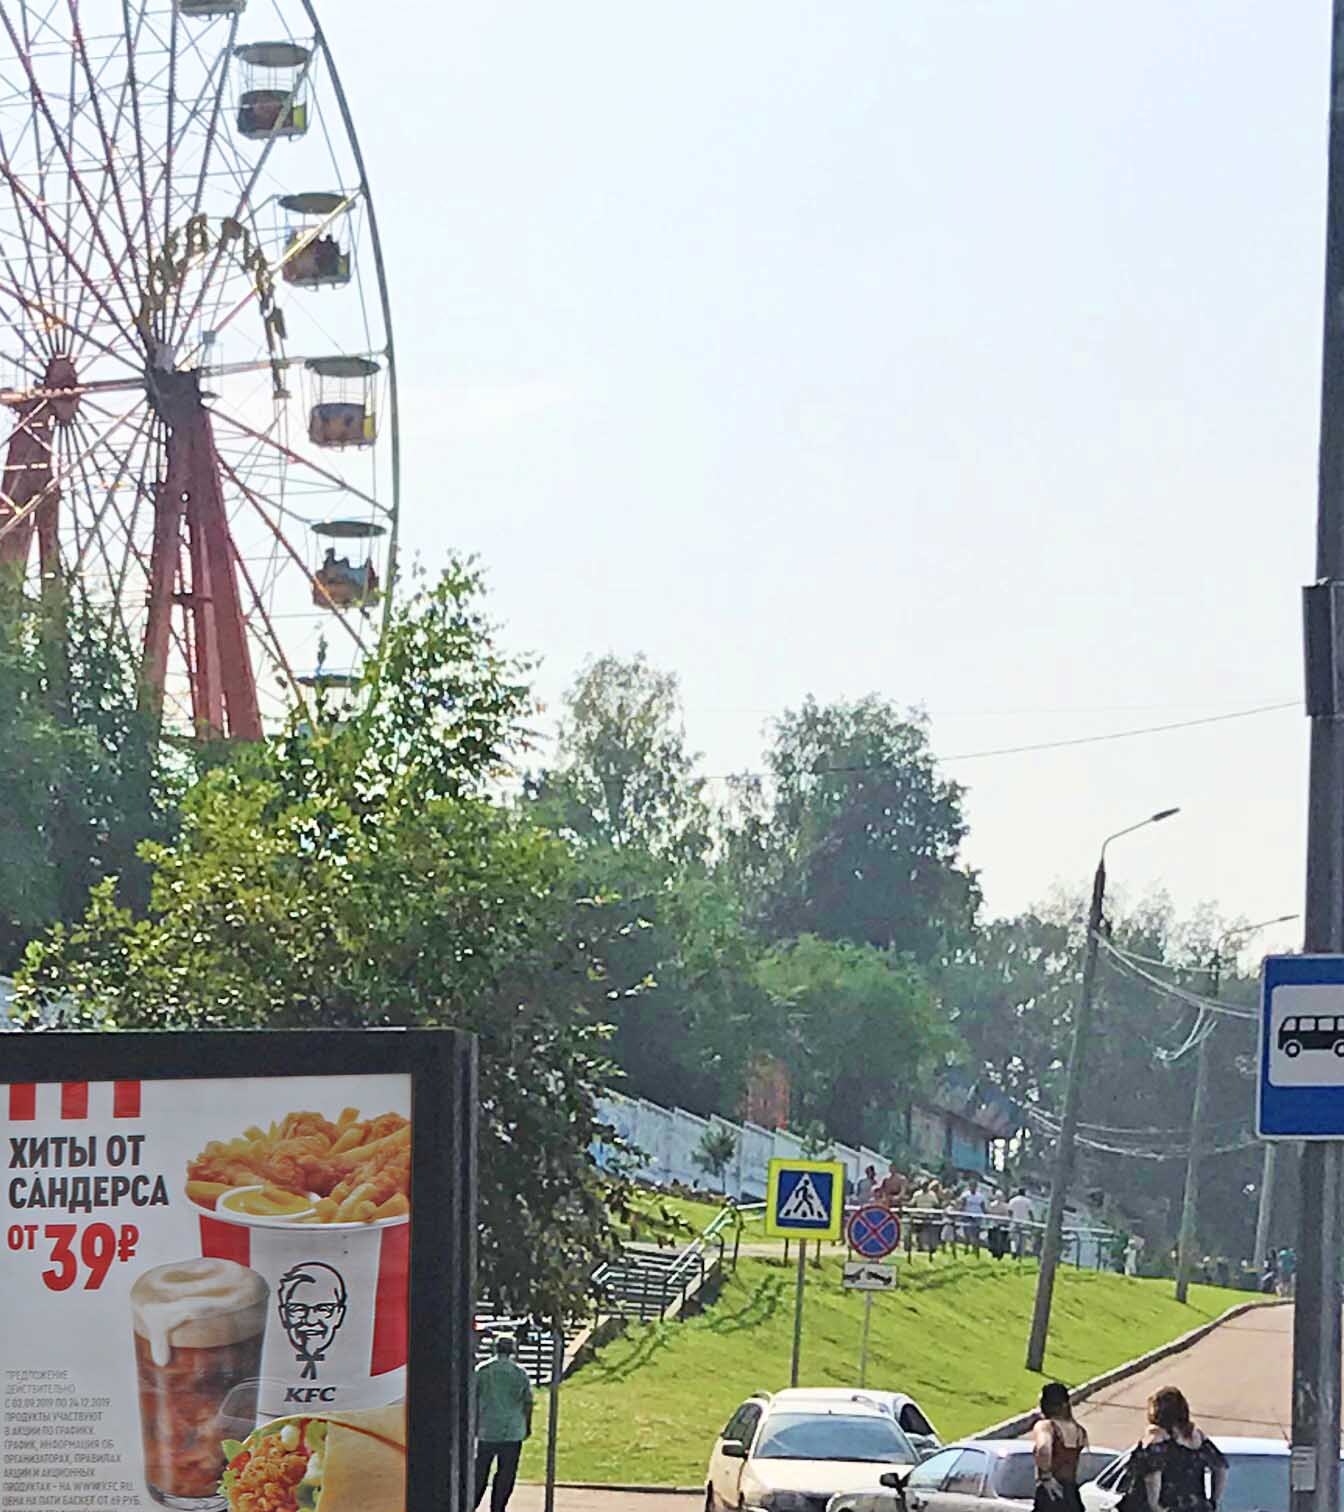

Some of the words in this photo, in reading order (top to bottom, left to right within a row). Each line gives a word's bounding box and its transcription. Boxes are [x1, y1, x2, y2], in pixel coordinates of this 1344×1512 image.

[8, 1136, 97, 1169] ХИТЫ
[106, 1134, 146, 1167] ОТ
[7, 1224, 39, 1250] ОТ
[284, 1387, 336, 1403] KFC
